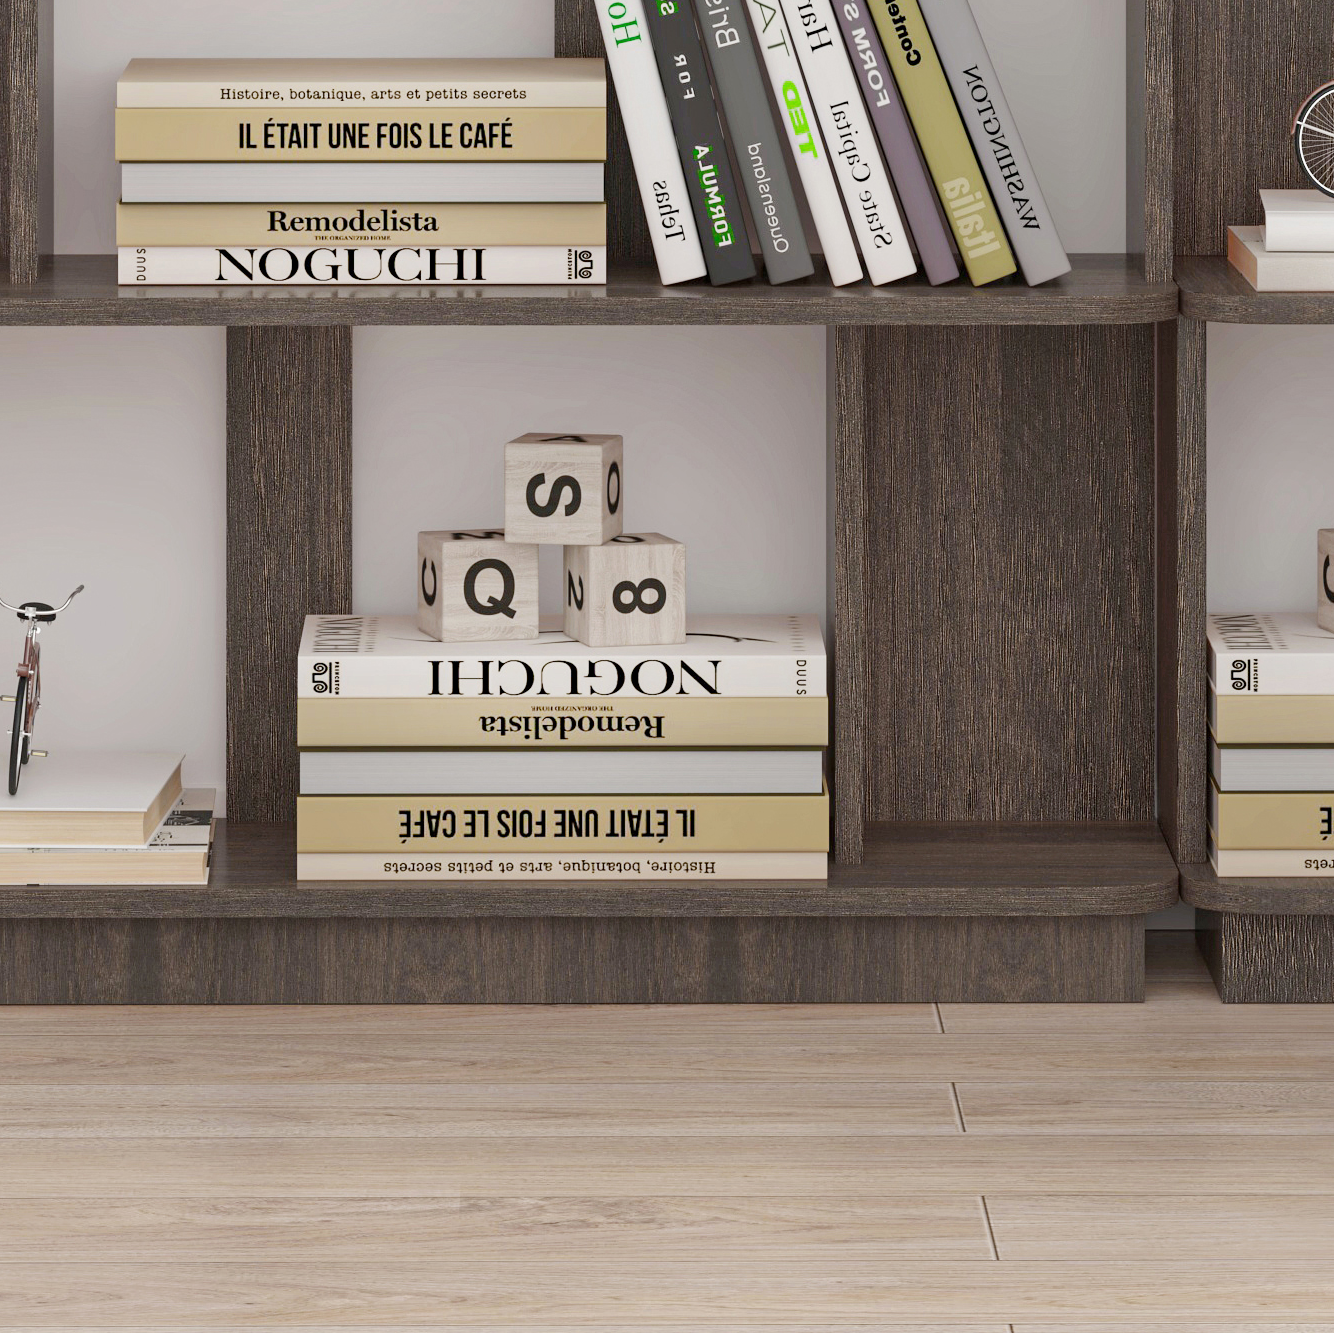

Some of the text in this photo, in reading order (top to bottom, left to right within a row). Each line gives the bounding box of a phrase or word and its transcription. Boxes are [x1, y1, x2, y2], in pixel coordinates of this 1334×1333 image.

[219, 87, 527, 101] Histoire, botanique, arts et petits secrets
[238, 116, 512, 148] IL ÉTAIT UNE FOIS LE CAFÉ
[266, 208, 438, 232] Remodelista
[136, 247, 146, 280] DUUS
[214, 246, 486, 281] NOGUCHI
[525, 471, 581, 517] S
[462, 558, 515, 618] Q
[612, 577, 666, 614] 8
[427, 658, 721, 695] NOGUCHI
[479, 716, 666, 739] Remodelista
[398, 808, 695, 842] IL ÉTAIT UNE FOIS LE CAFÉ
